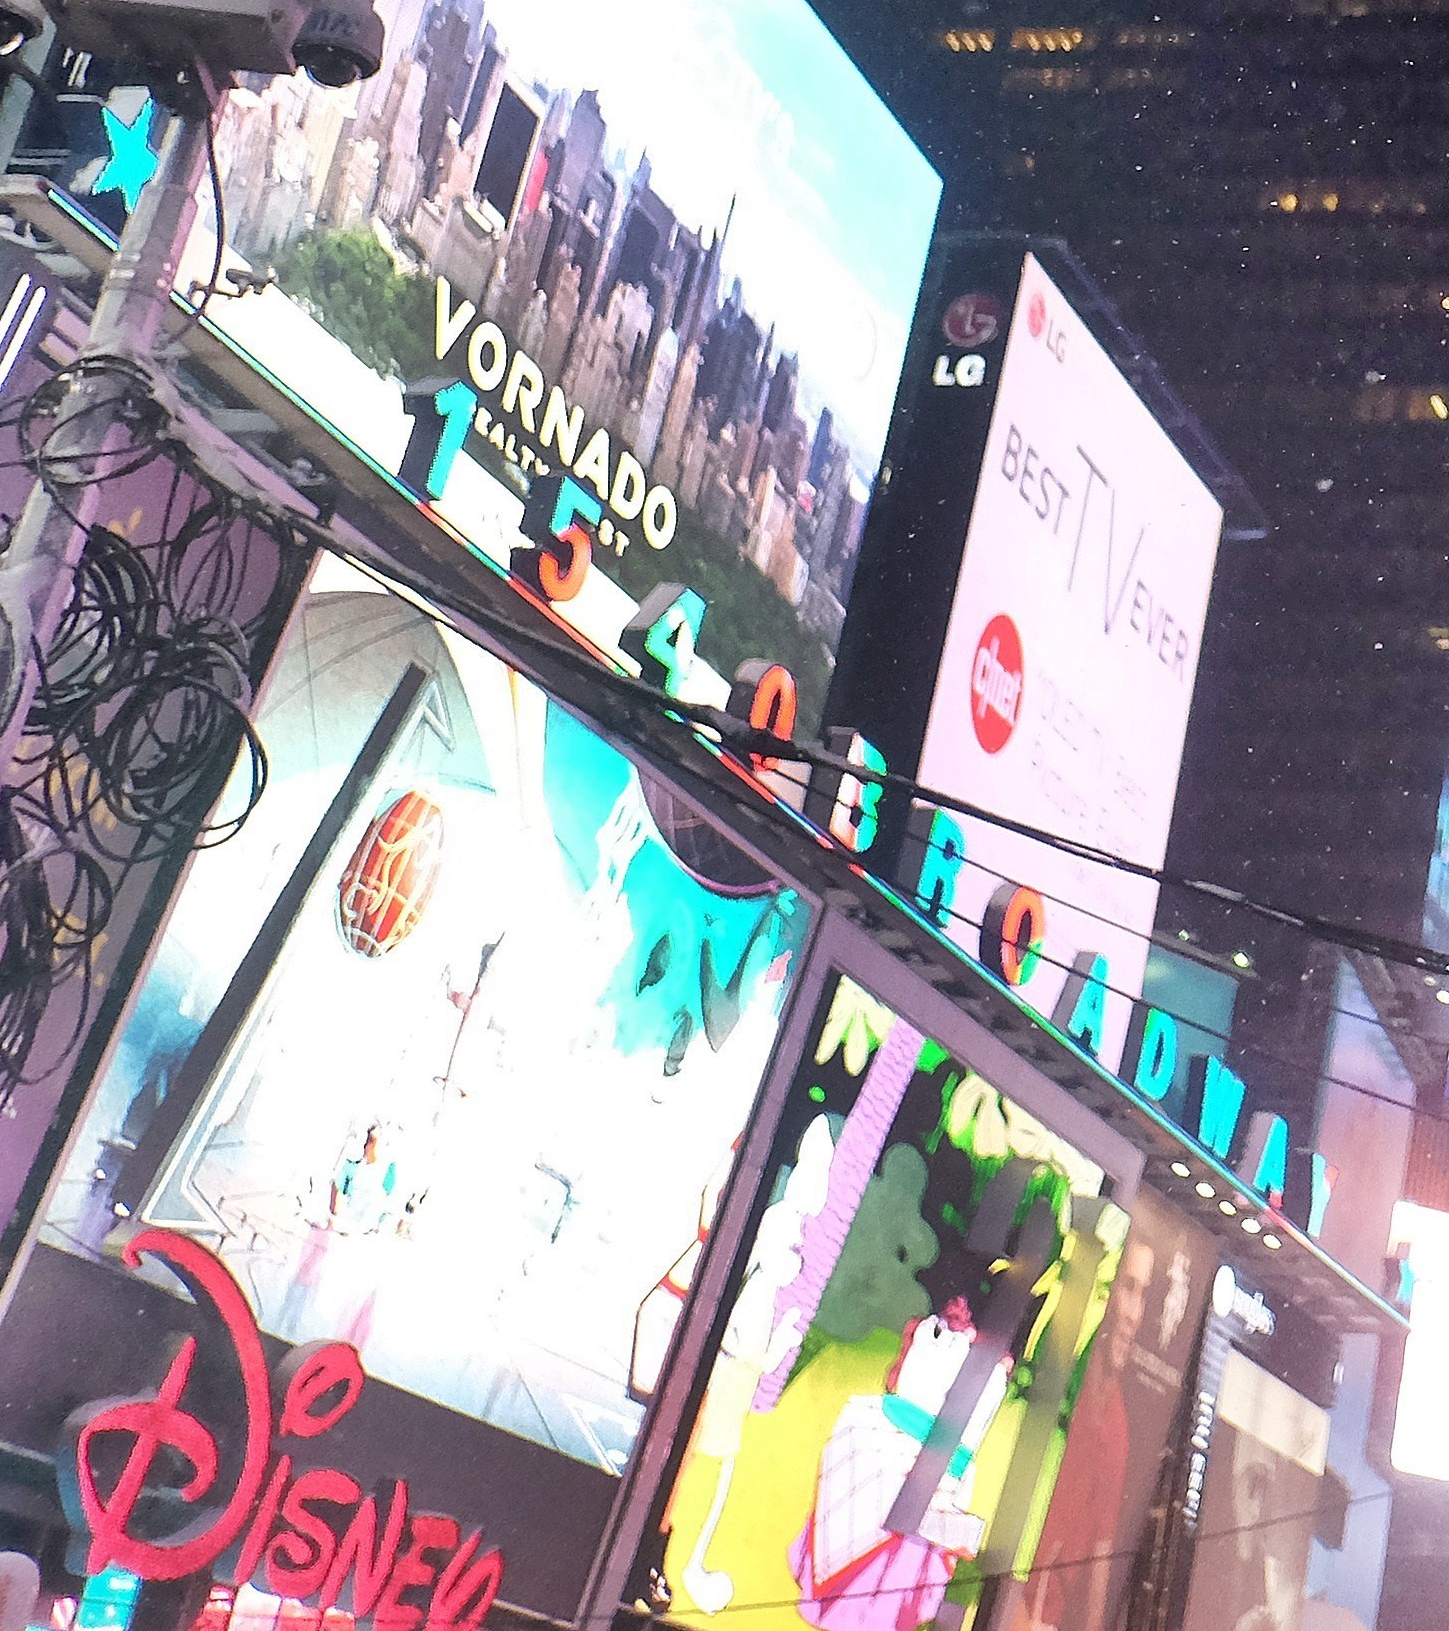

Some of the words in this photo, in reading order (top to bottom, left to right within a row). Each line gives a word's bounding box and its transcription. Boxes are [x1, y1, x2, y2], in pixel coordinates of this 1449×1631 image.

[436, 275, 677, 551] VORNADO
[932, 354, 986, 387] LG
[1046, 318, 1067, 363] LG
[427, 379, 798, 770] 1540
[1001, 423, 1071, 535] BEST
[1067, 444, 1145, 635] TV
[1131, 578, 1189, 683] EVER
